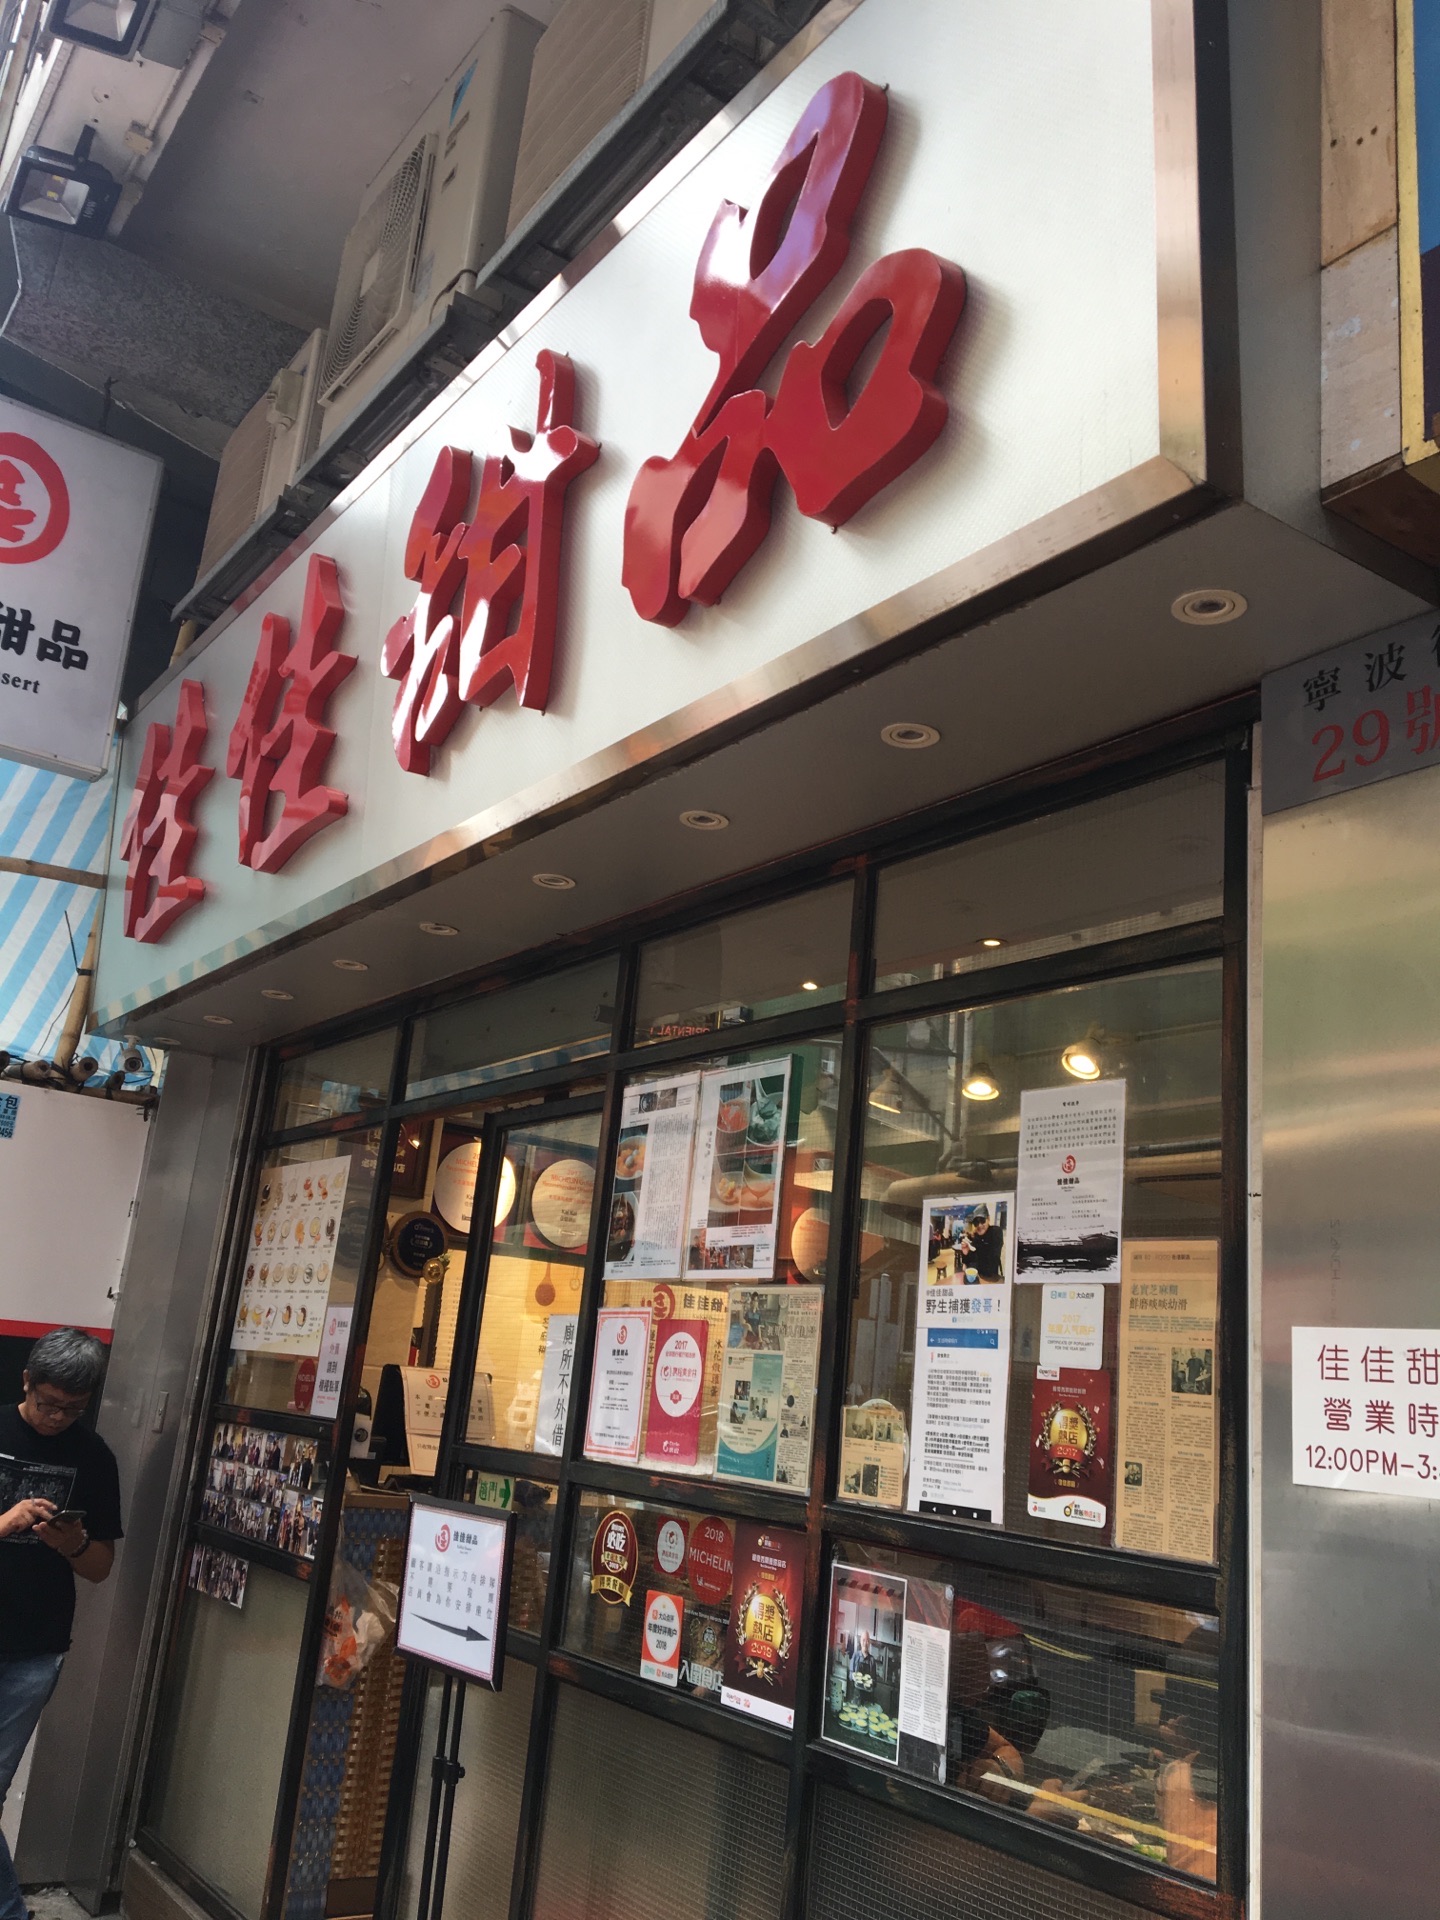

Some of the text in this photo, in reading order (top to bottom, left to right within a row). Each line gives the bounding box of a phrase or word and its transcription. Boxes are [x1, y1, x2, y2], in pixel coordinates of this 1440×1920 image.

[120, 70, 968, 944] 佳佳甜品
[0, 671, 40, 694] sert
[683, 1293, 728, 1313] 佳佳甜
[675, 1340, 689, 1351] 2017
[1317, 1344, 1440, 1386] 佳佳甜
[552, 1323, 575, 1446] 廁所不外借
[1323, 1397, 1440, 1439] 營業時
[1305, 1444, 1440, 1481] 12:00PM-3:
[704, 1526, 724, 1543] 2018
[689, 1547, 734, 1575] MICHELIN
[647, 1623, 678, 1638] 年度好评商户
